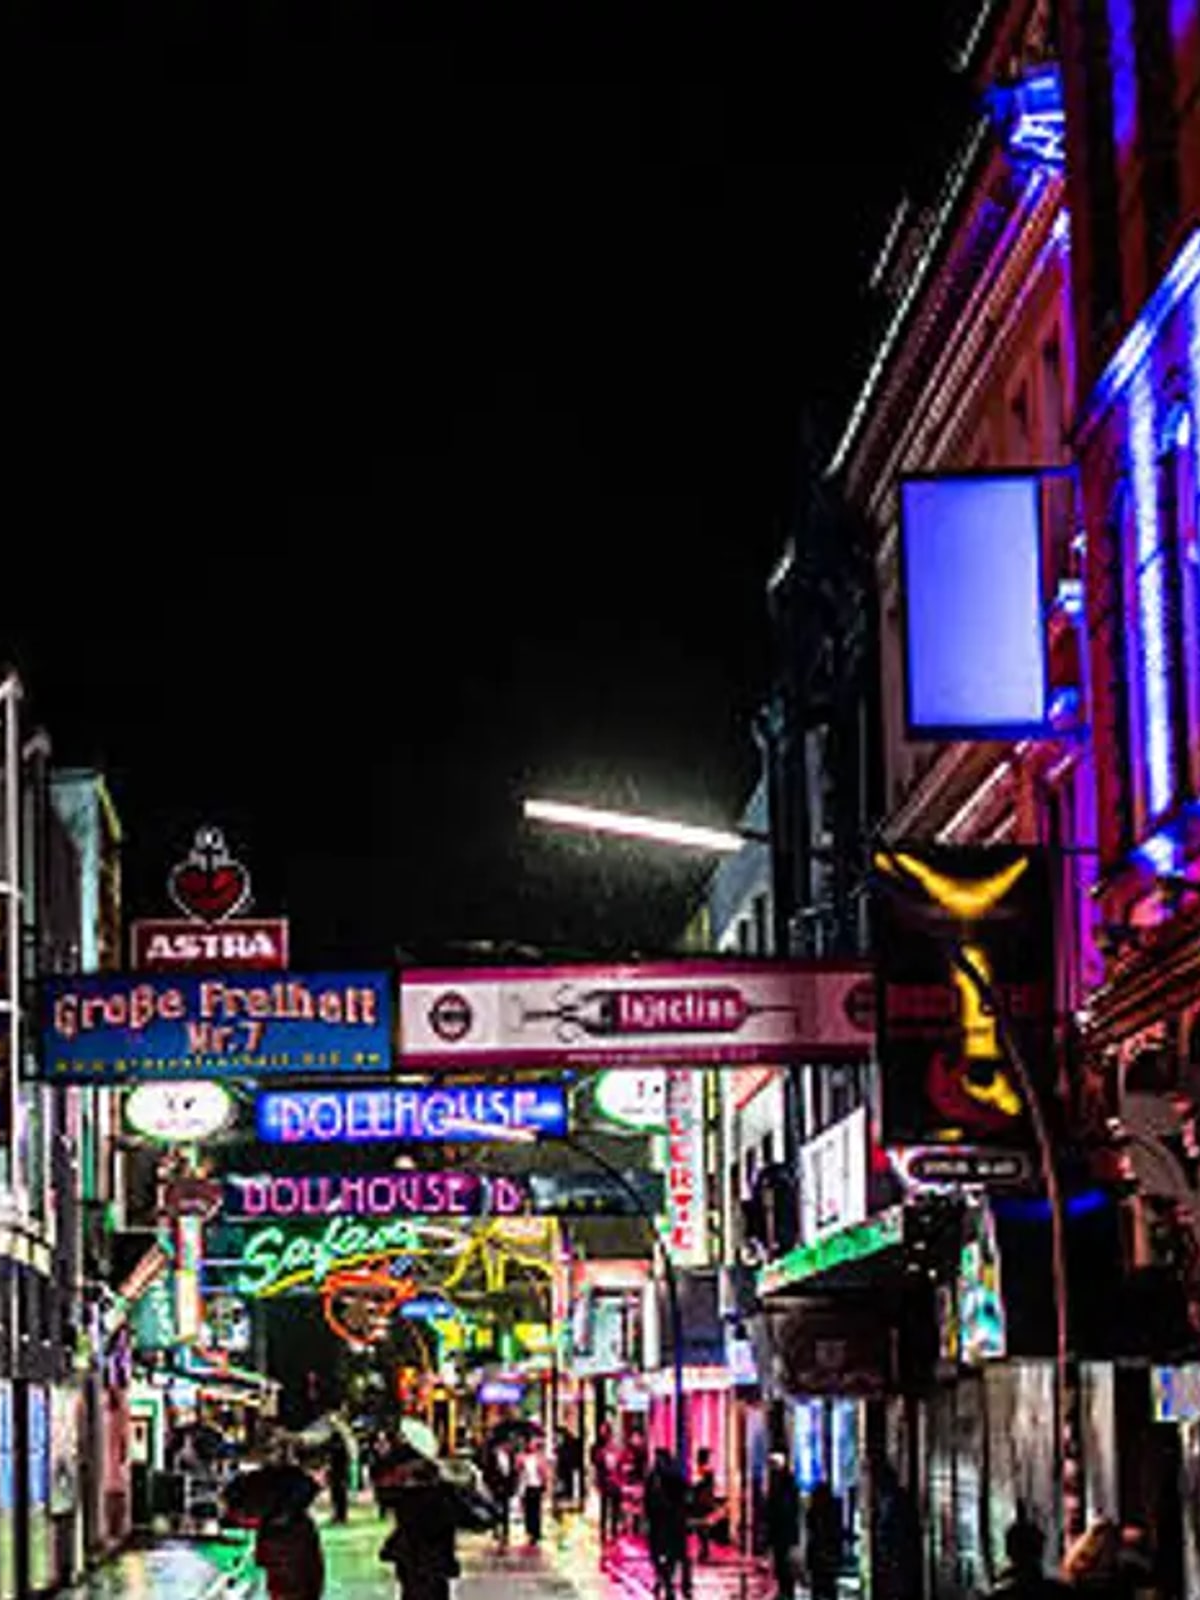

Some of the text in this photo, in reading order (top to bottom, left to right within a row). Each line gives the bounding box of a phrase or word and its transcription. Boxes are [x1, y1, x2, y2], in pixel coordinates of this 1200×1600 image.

[145, 933, 278, 961] ASTRA
[53, 981, 186, 1038] Große
[200, 980, 377, 1025] Freiheit
[619, 991, 741, 1029] Injection
[279, 1086, 538, 1142] DOLLHOUSE
[241, 1174, 468, 1214] DOLLHOUSE
